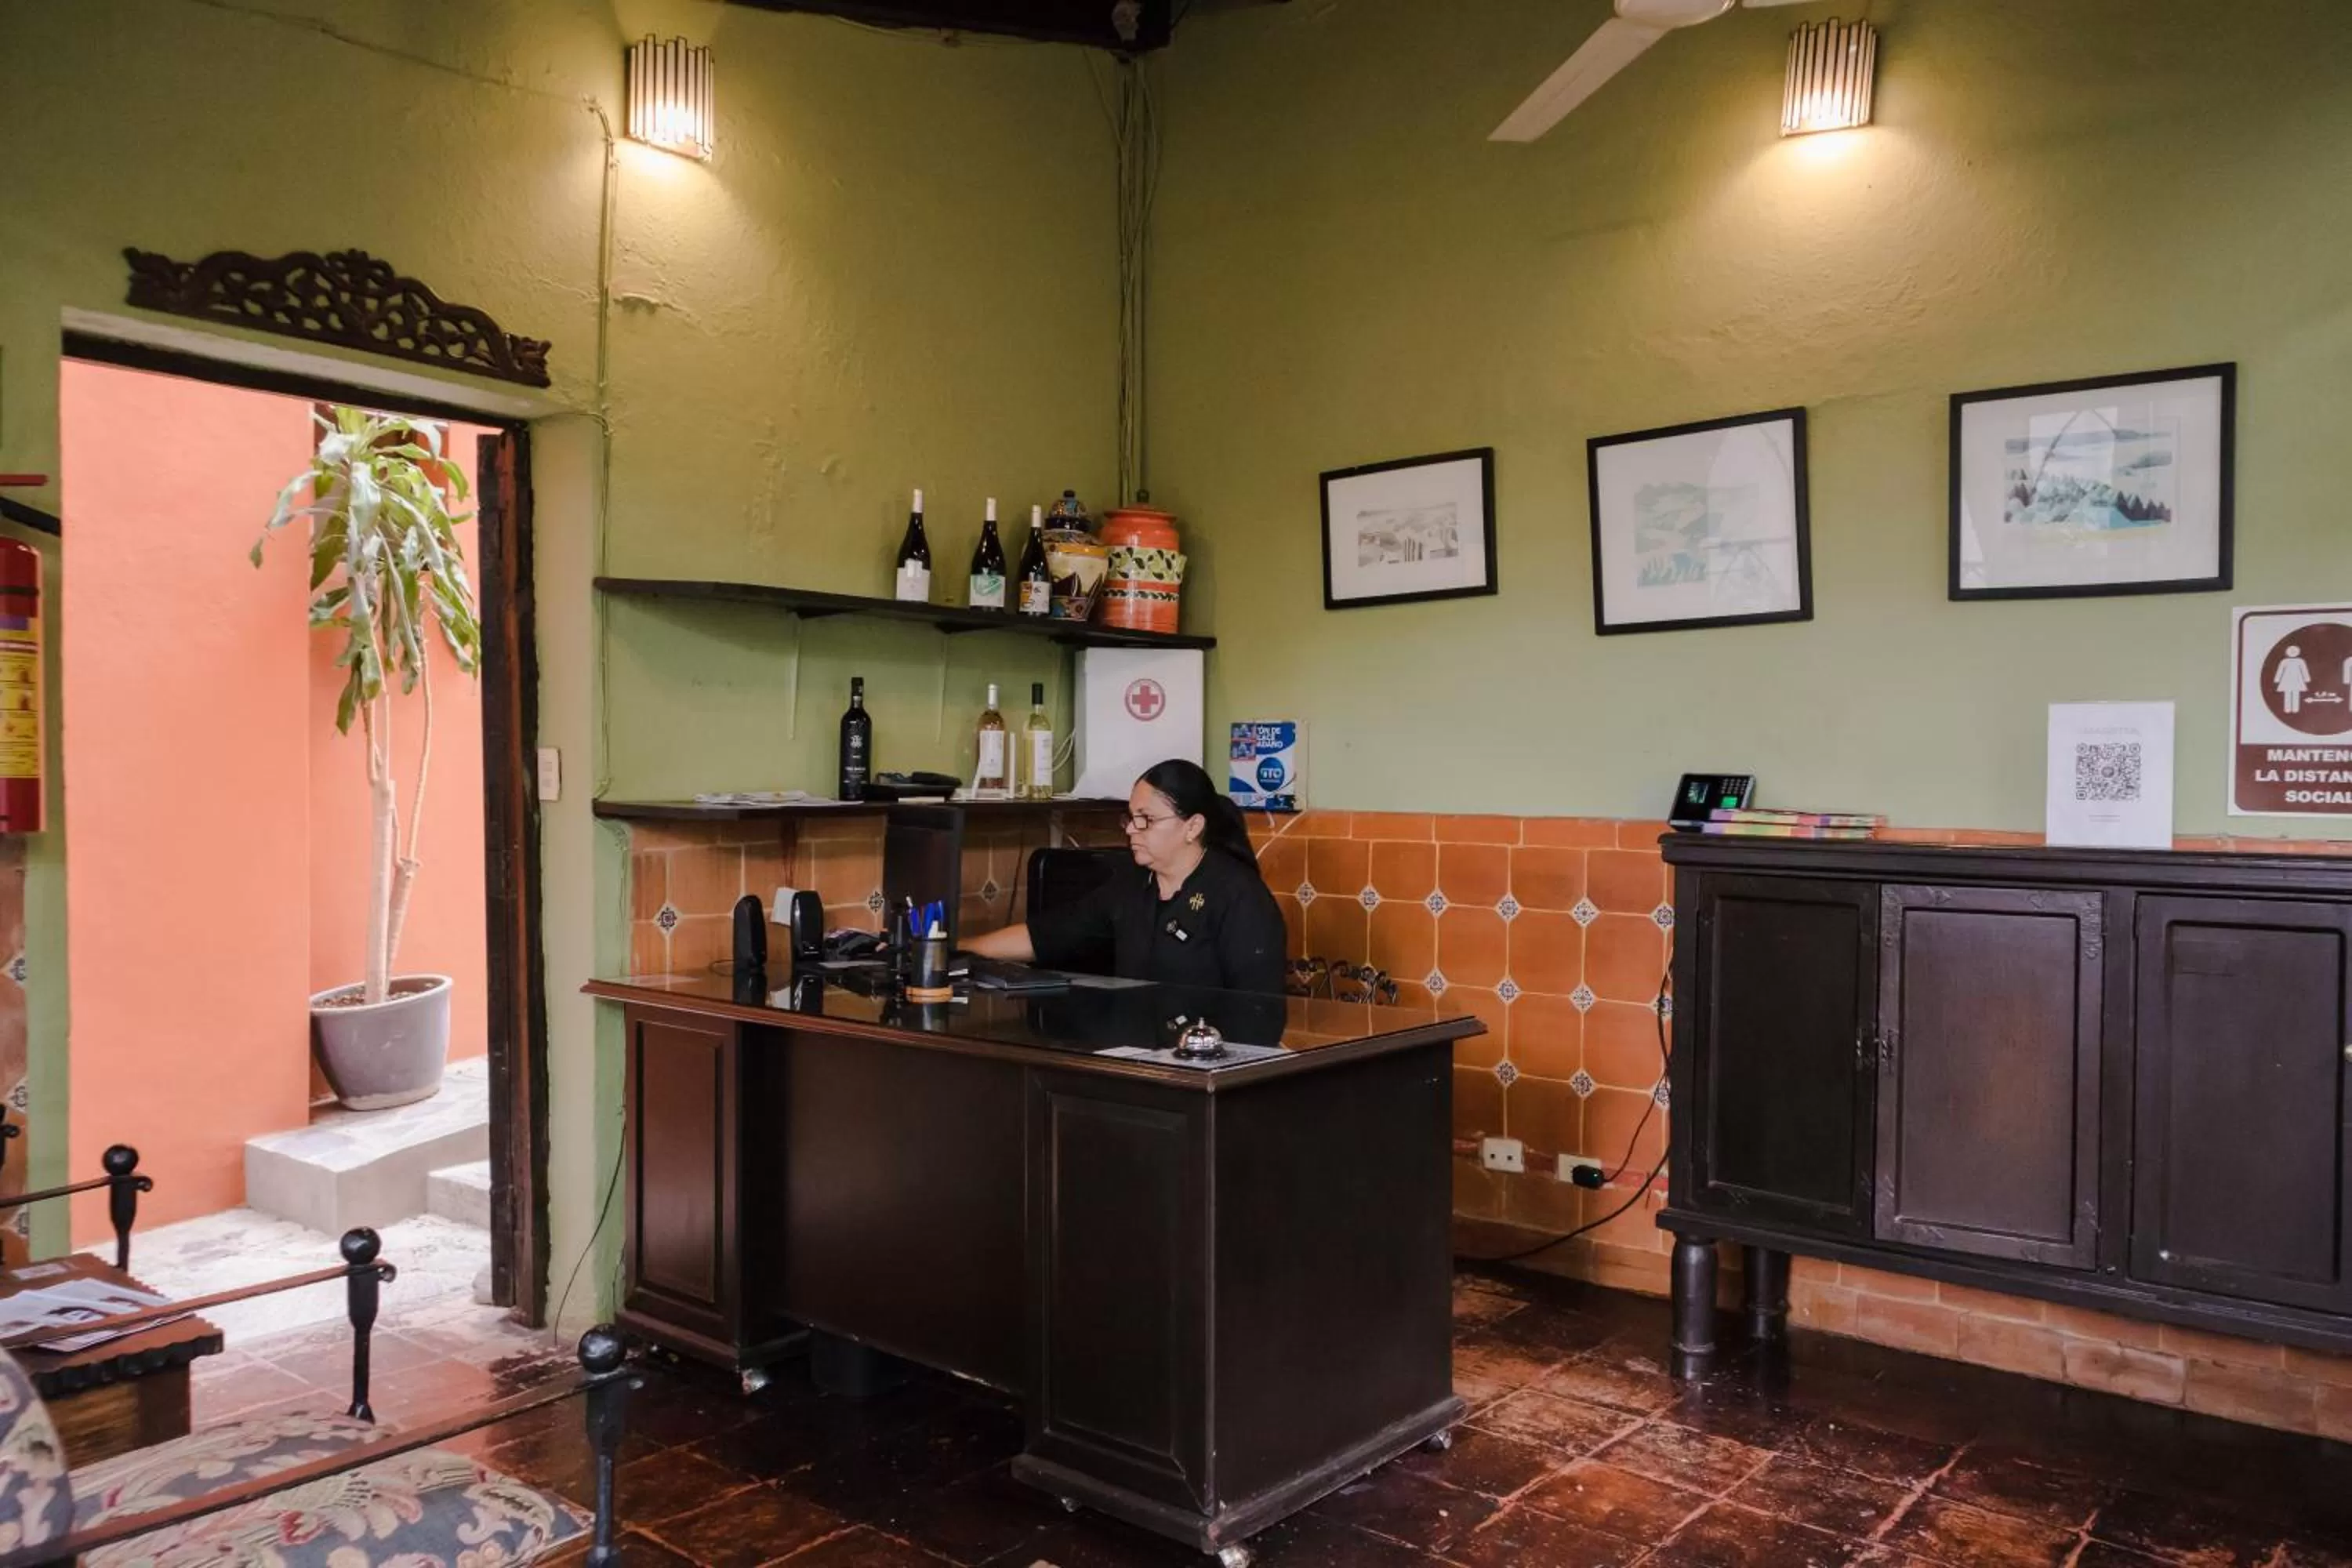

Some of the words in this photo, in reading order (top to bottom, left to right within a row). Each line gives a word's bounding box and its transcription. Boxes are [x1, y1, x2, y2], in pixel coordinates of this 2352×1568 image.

[2267, 749, 2352, 762] MANTEN
[2255, 769, 2279, 782] LA
[2284, 770, 2352, 782] DISTAN
[2285, 790, 2352, 804] SOCIAL
